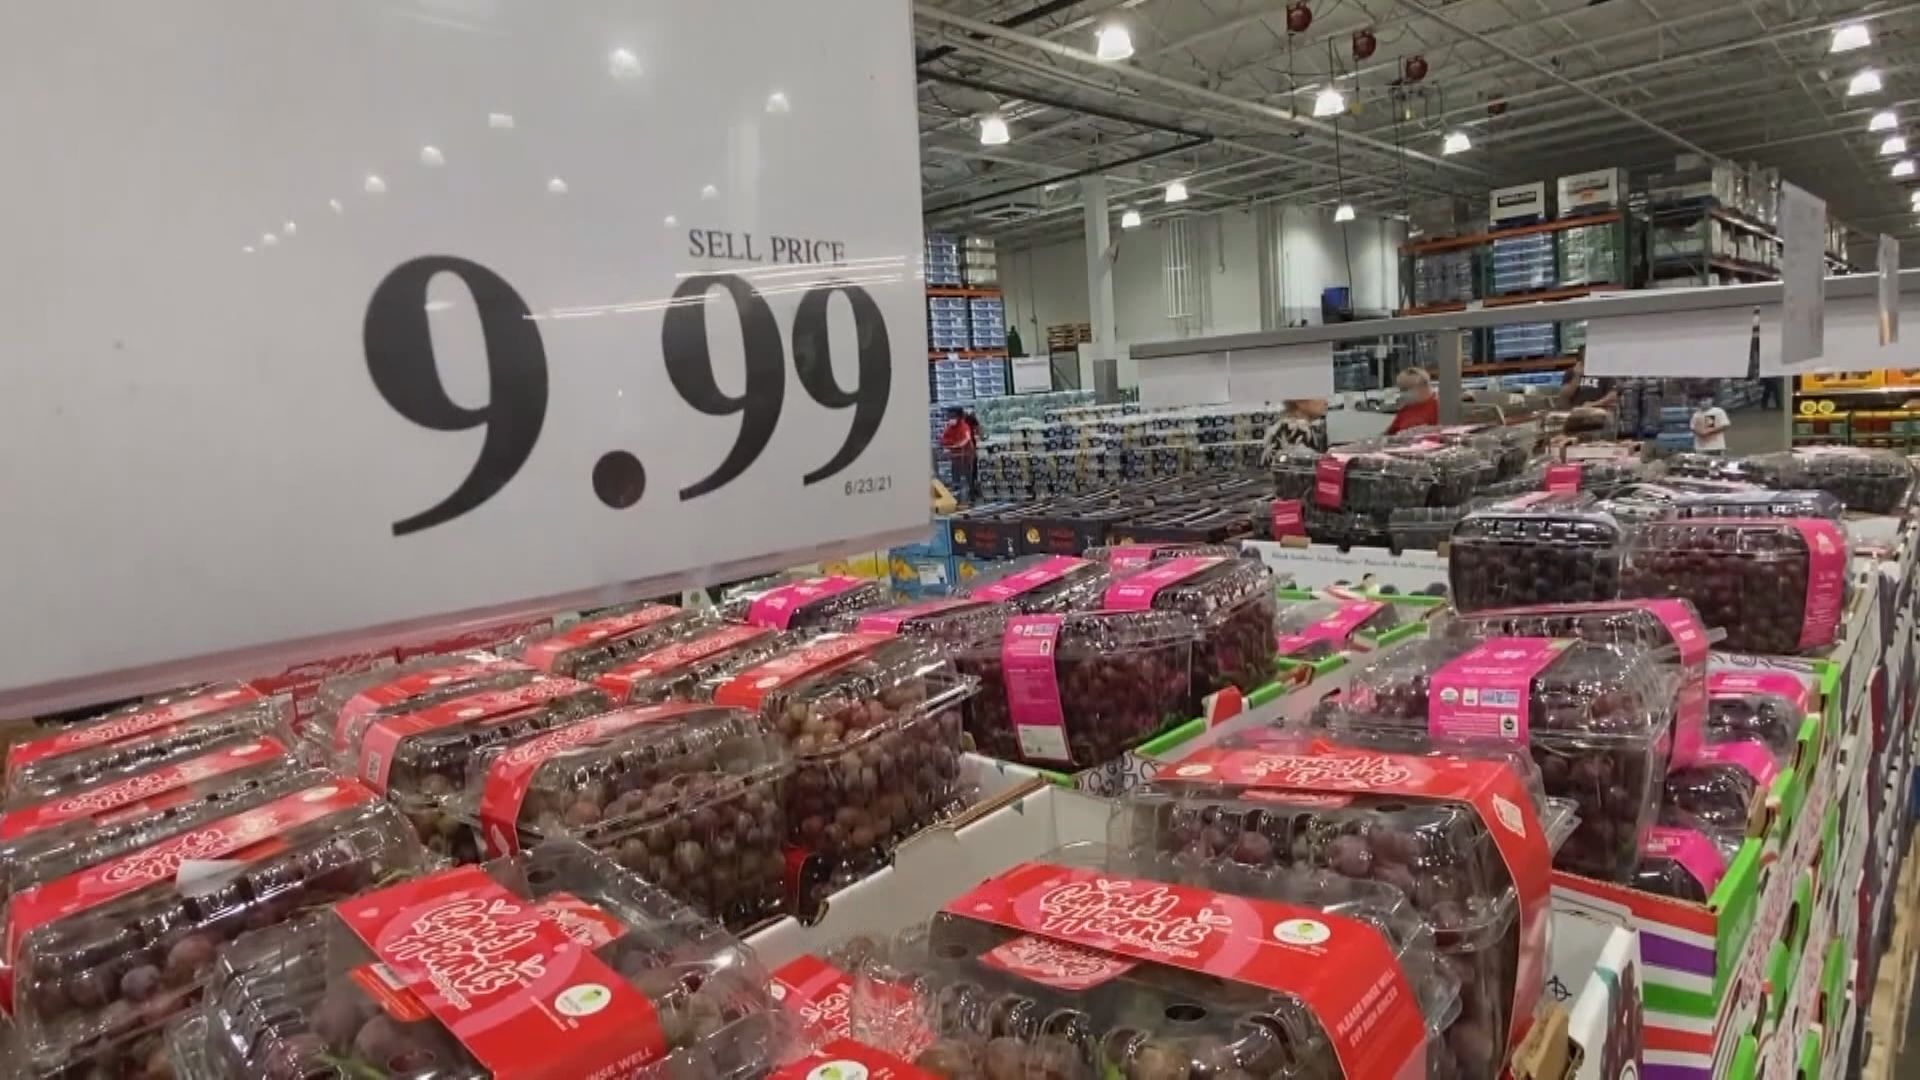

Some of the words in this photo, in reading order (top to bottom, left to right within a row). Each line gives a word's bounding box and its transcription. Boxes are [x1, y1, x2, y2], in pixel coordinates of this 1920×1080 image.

[688, 229, 762, 263] SELL
[769, 234, 846, 267] PRICE
[362, 254, 892, 538] 9.99
[844, 477, 893, 497] 6/23/21
[1040, 879, 1180, 919] Candy
[412, 899, 541, 957] Candy
[1041, 905, 1212, 945] Hearts
[385, 929, 520, 995] Hearts
[586, 1063, 616, 1080] INSE
[617, 1046, 653, 1070] WELL
